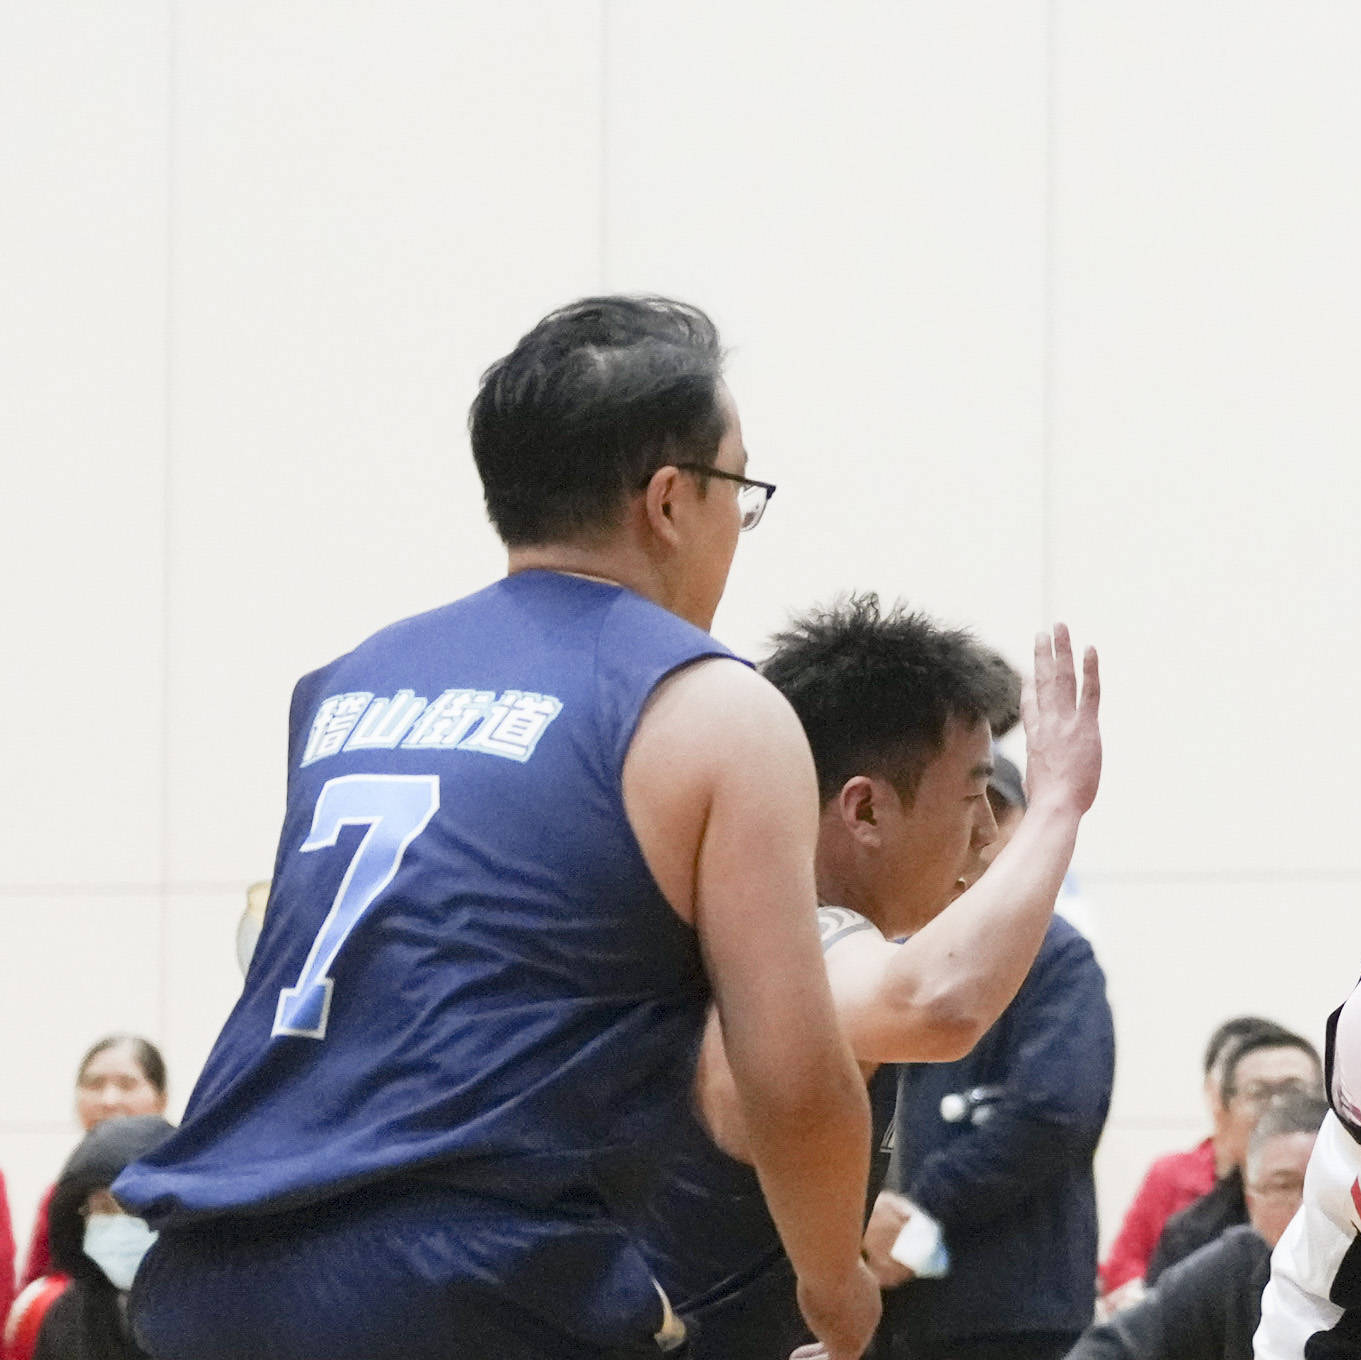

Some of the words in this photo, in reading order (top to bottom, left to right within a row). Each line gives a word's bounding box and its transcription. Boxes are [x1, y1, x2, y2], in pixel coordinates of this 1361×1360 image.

[300, 688, 564, 768] 稽山街道
[271, 773, 441, 1041] 7
